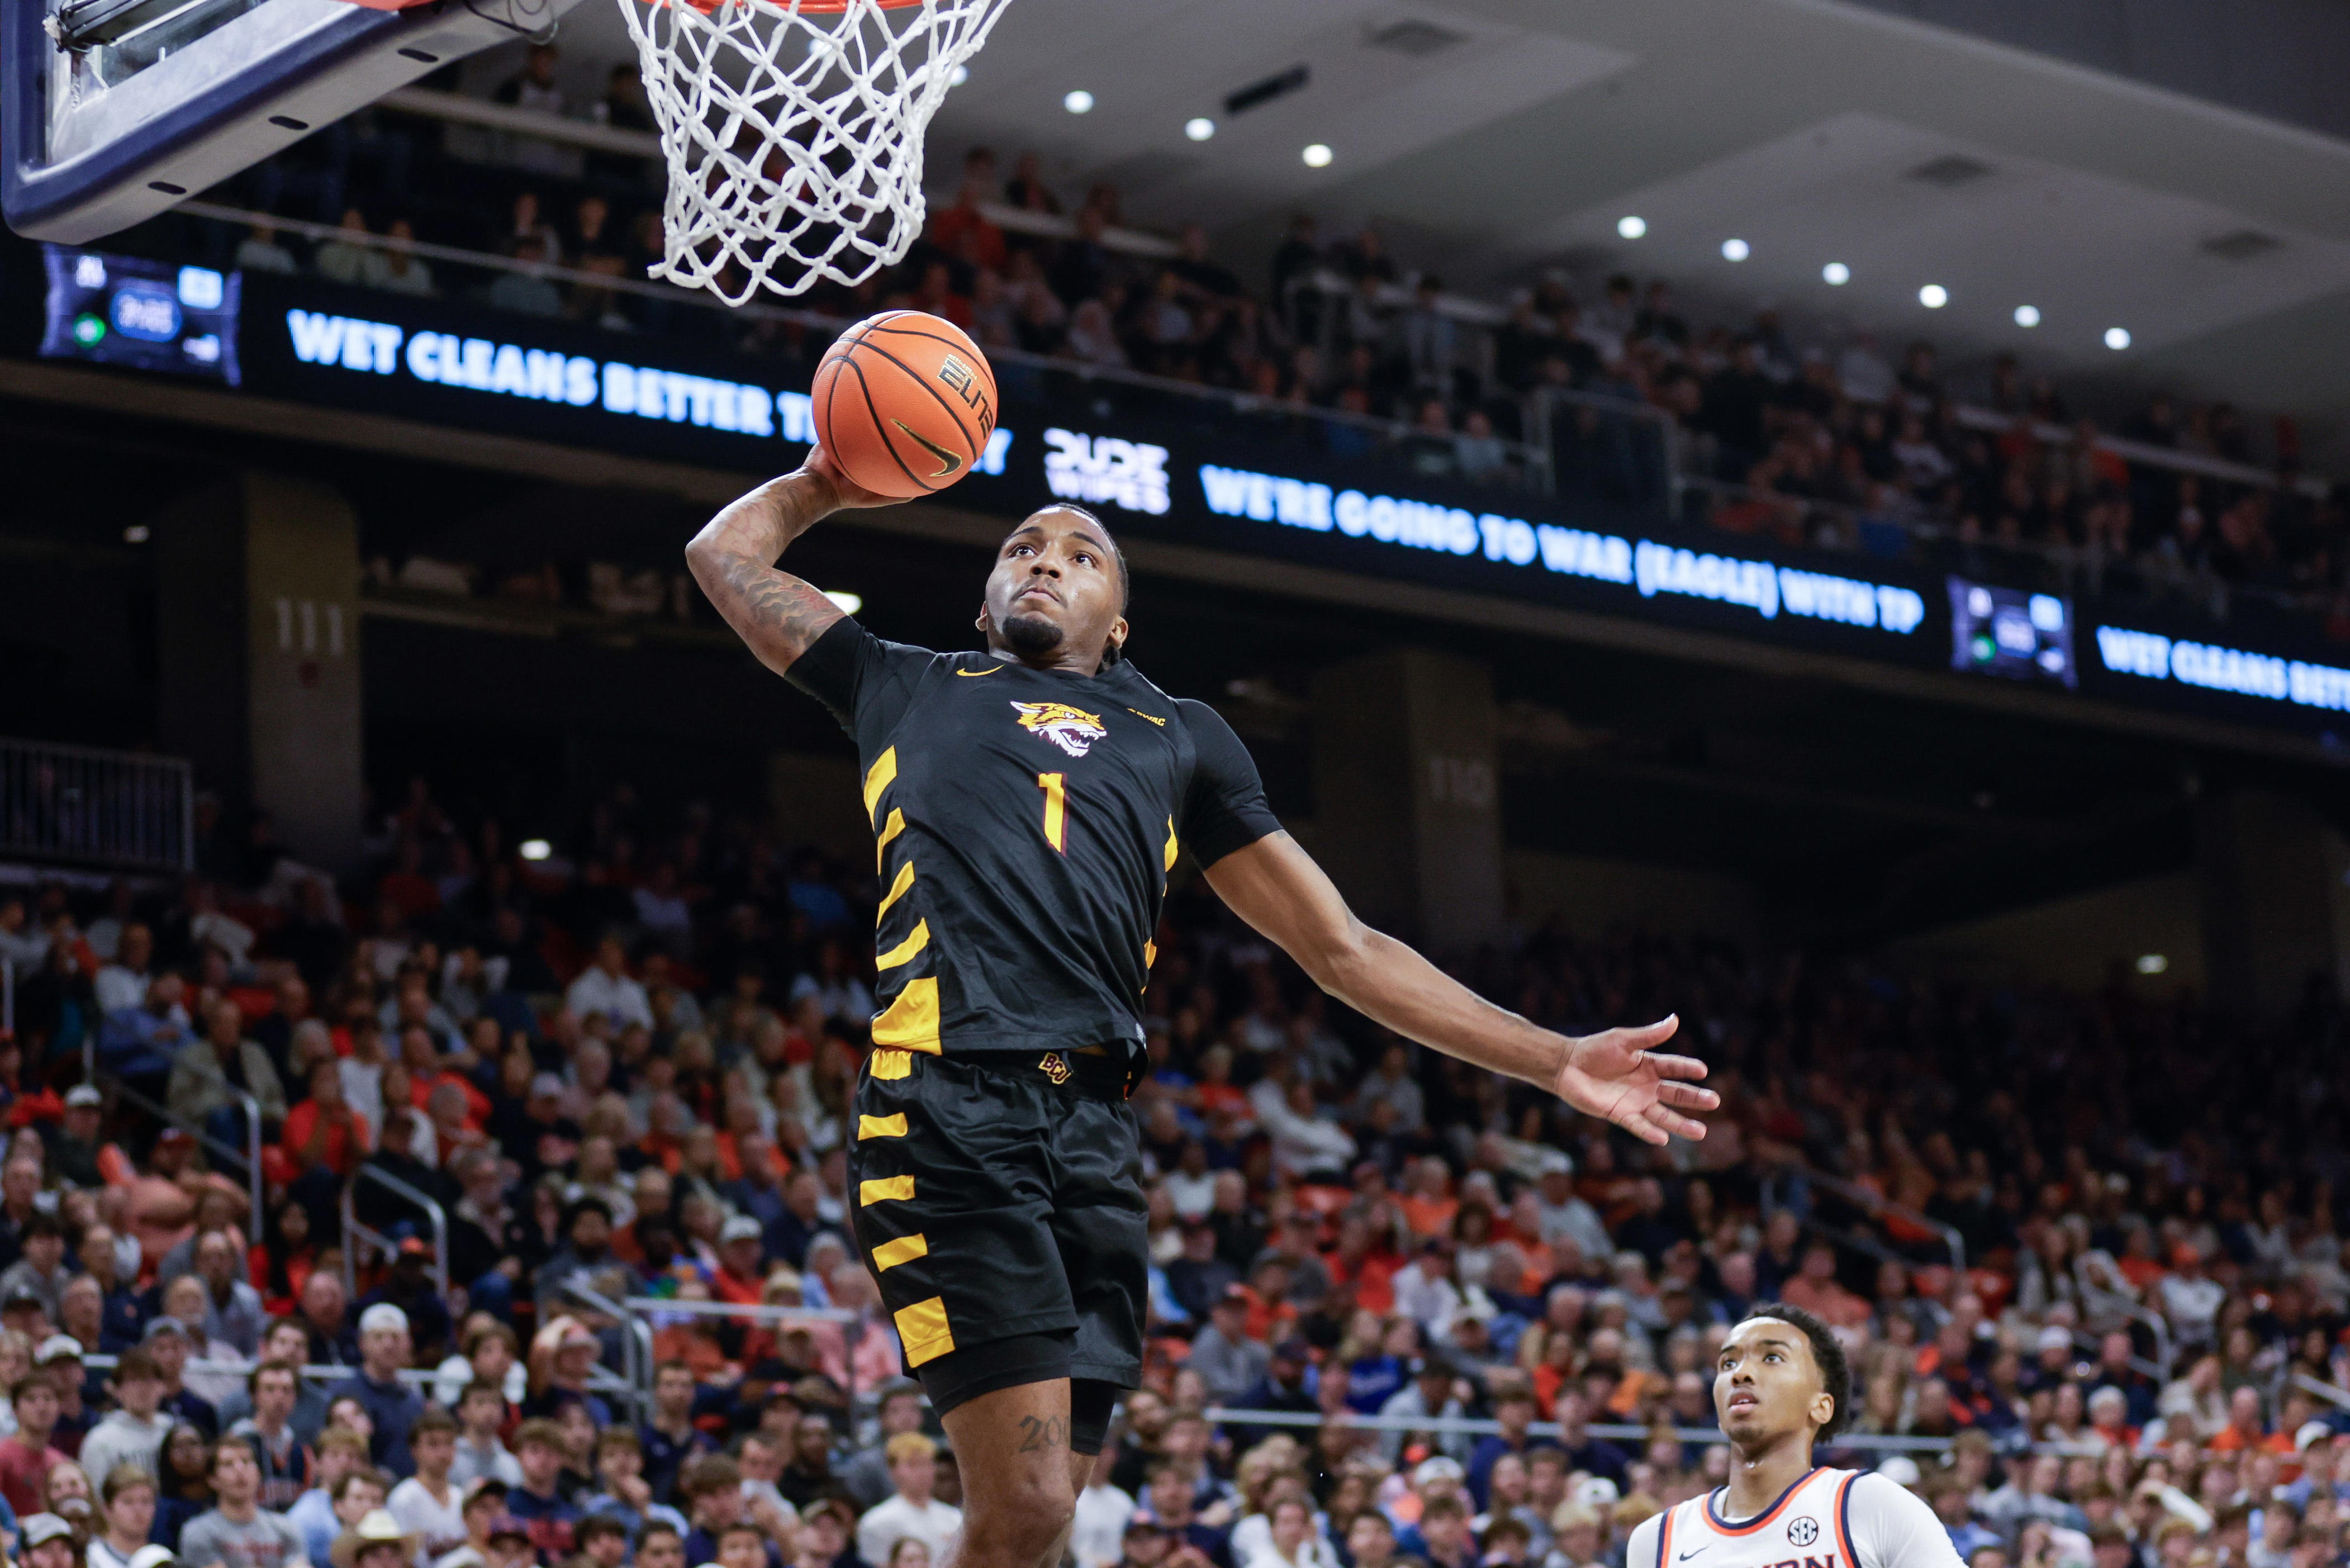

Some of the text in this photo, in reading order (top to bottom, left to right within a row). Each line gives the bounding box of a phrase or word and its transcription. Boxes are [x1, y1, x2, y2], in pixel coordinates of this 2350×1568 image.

[286, 309, 404, 375] WET
[405, 331, 599, 407] CLEANS
[602, 362, 775, 437] BETTER
[937, 357, 994, 440] ELITE
[1043, 428, 1169, 483] DUDE
[1045, 471, 1171, 515] WIPES
[1335, 490, 1480, 555] GOING
[1479, 514, 1539, 566] TO
[1538, 524, 1633, 585] WAR
[1779, 567, 1878, 628] WITH
[277, 596, 343, 658] 111
[2096, 625, 2172, 679] WET
[2171, 640, 2288, 700] CLEANS
[1038, 772, 1068, 857] 1
[1038, 1052, 1071, 1084] BCU
[1788, 1517, 1818, 1546] SEC
